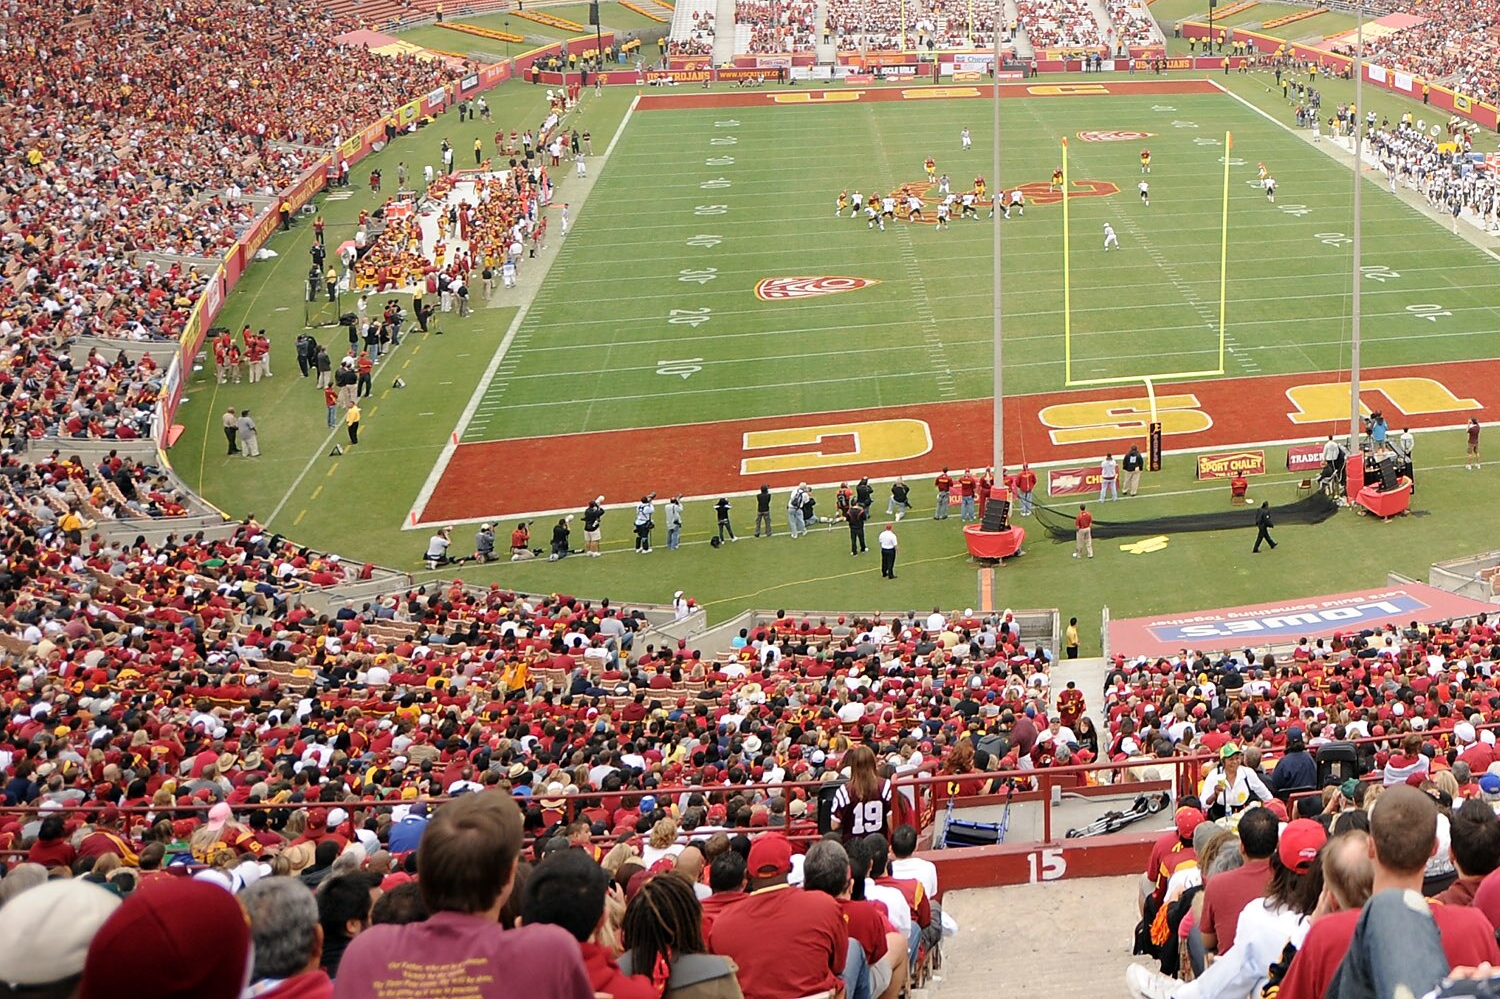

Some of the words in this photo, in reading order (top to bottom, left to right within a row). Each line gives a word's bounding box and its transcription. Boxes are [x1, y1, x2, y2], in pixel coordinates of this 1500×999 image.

[668, 71, 710, 81] TROJANS
[668, 307, 711, 324] 20
[656, 357, 704, 376] 10
[1200, 462, 1229, 473] SPORT
[1231, 460, 1262, 469] CHALET
[1227, 601, 1318, 619] Something
[1321, 595, 1365, 609] Build
[1149, 614, 1225, 627] Together
[1180, 601, 1403, 639] LOWE'S
[852, 800, 883, 835] 19
[1027, 848, 1067, 885] 15
